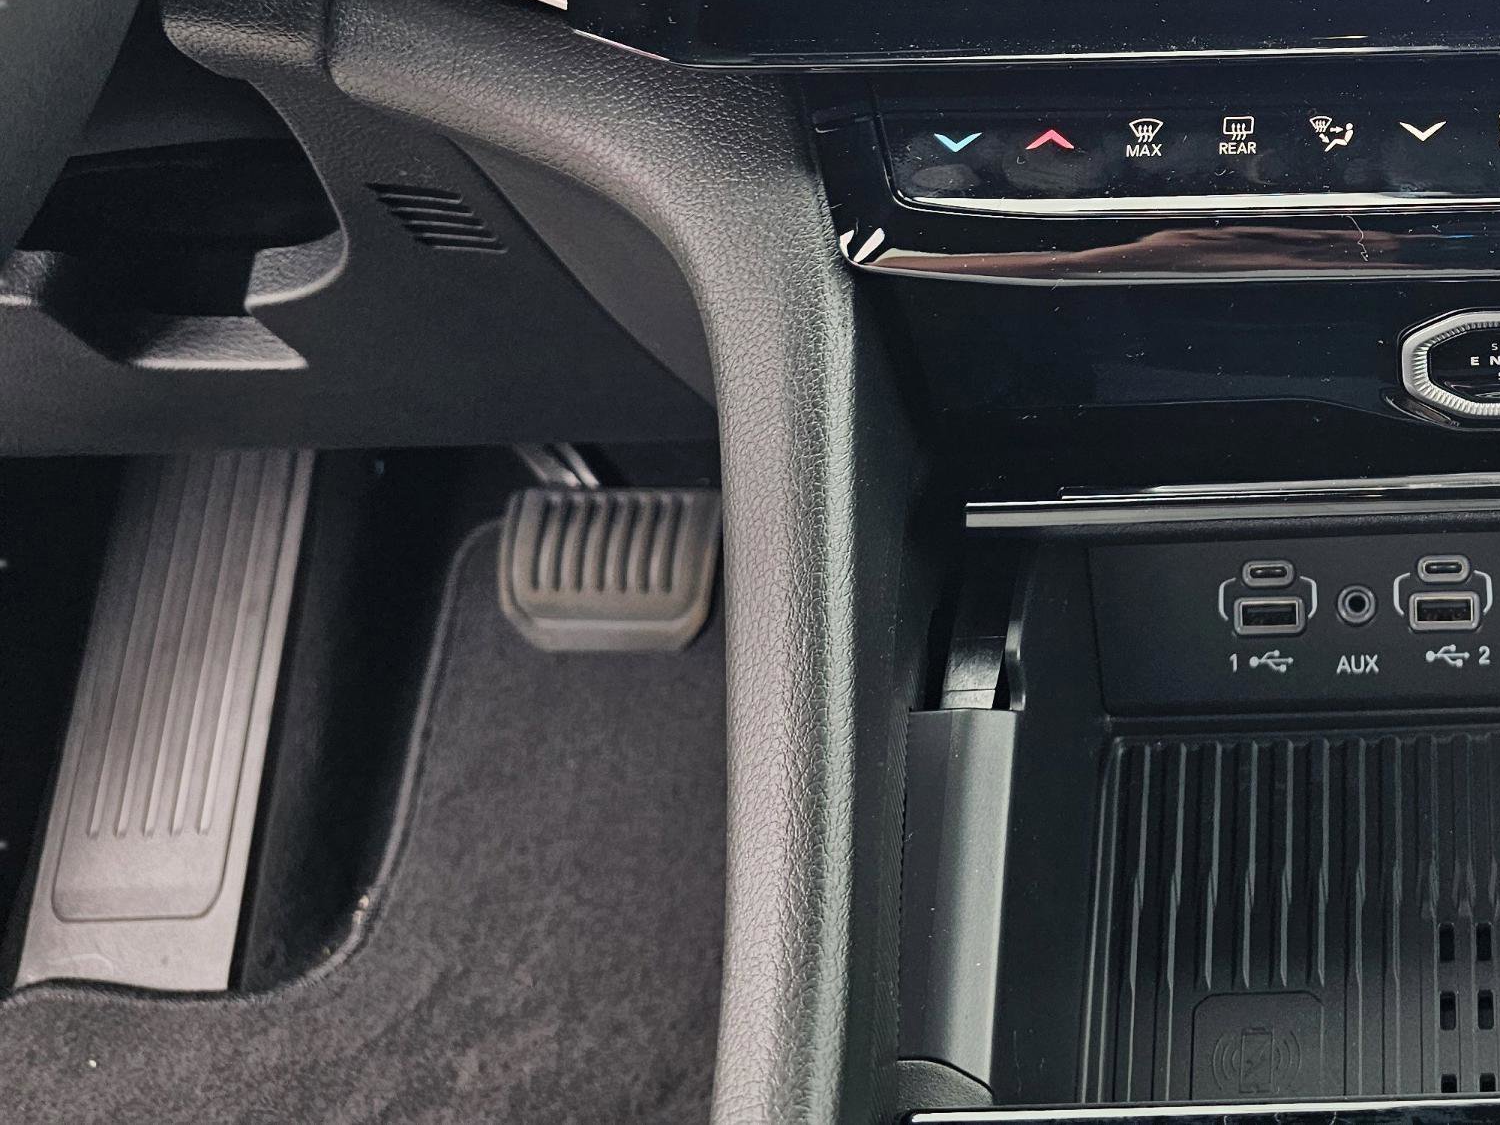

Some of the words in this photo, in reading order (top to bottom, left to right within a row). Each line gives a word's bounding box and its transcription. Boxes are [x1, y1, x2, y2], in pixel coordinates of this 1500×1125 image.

[1126, 143, 1163, 158] MAX
[1218, 141, 1257, 156] REAR
[1229, 654, 1238, 672] 1
[1336, 655, 1380, 673] AUX
[1478, 647, 1490, 666] 2
